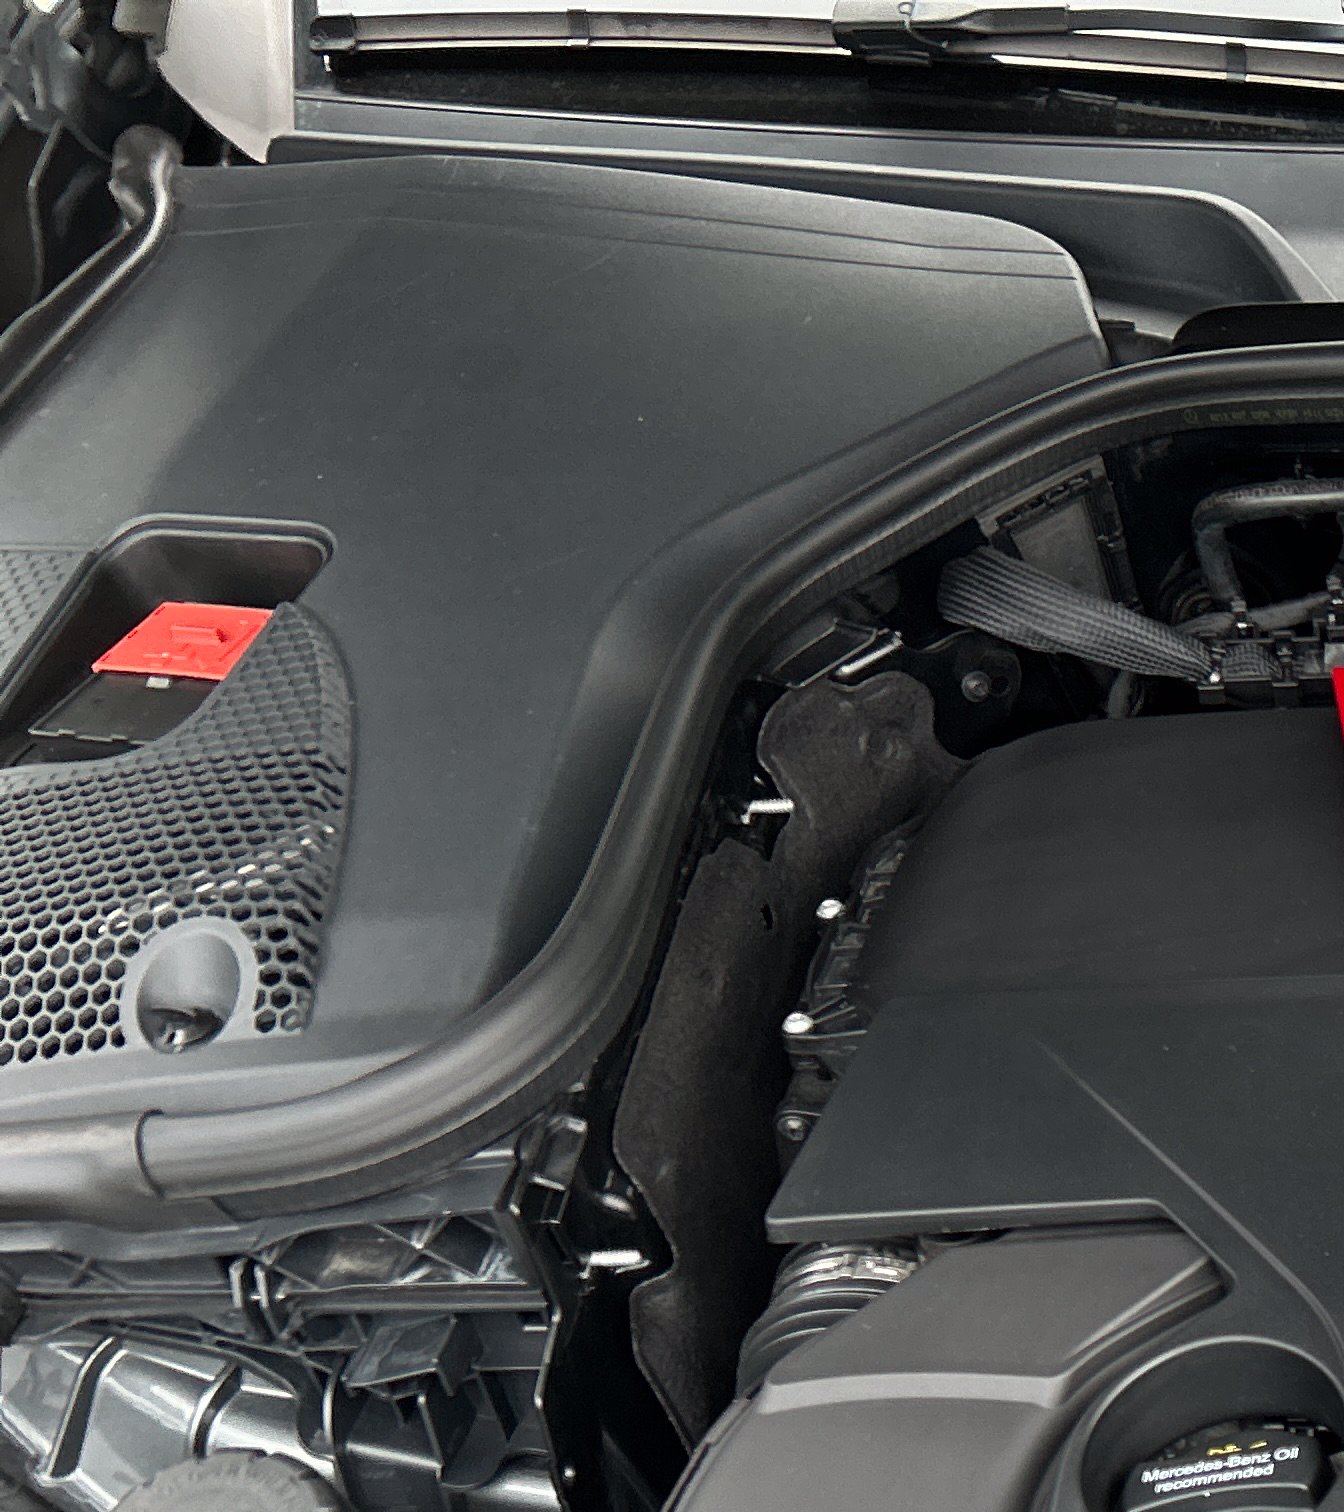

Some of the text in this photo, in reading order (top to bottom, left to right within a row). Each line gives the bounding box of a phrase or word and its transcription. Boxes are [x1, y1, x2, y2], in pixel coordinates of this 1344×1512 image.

[1141, 1445, 1300, 1483] Mercedes-Benz Oil
[1154, 1463, 1275, 1493] recommended
